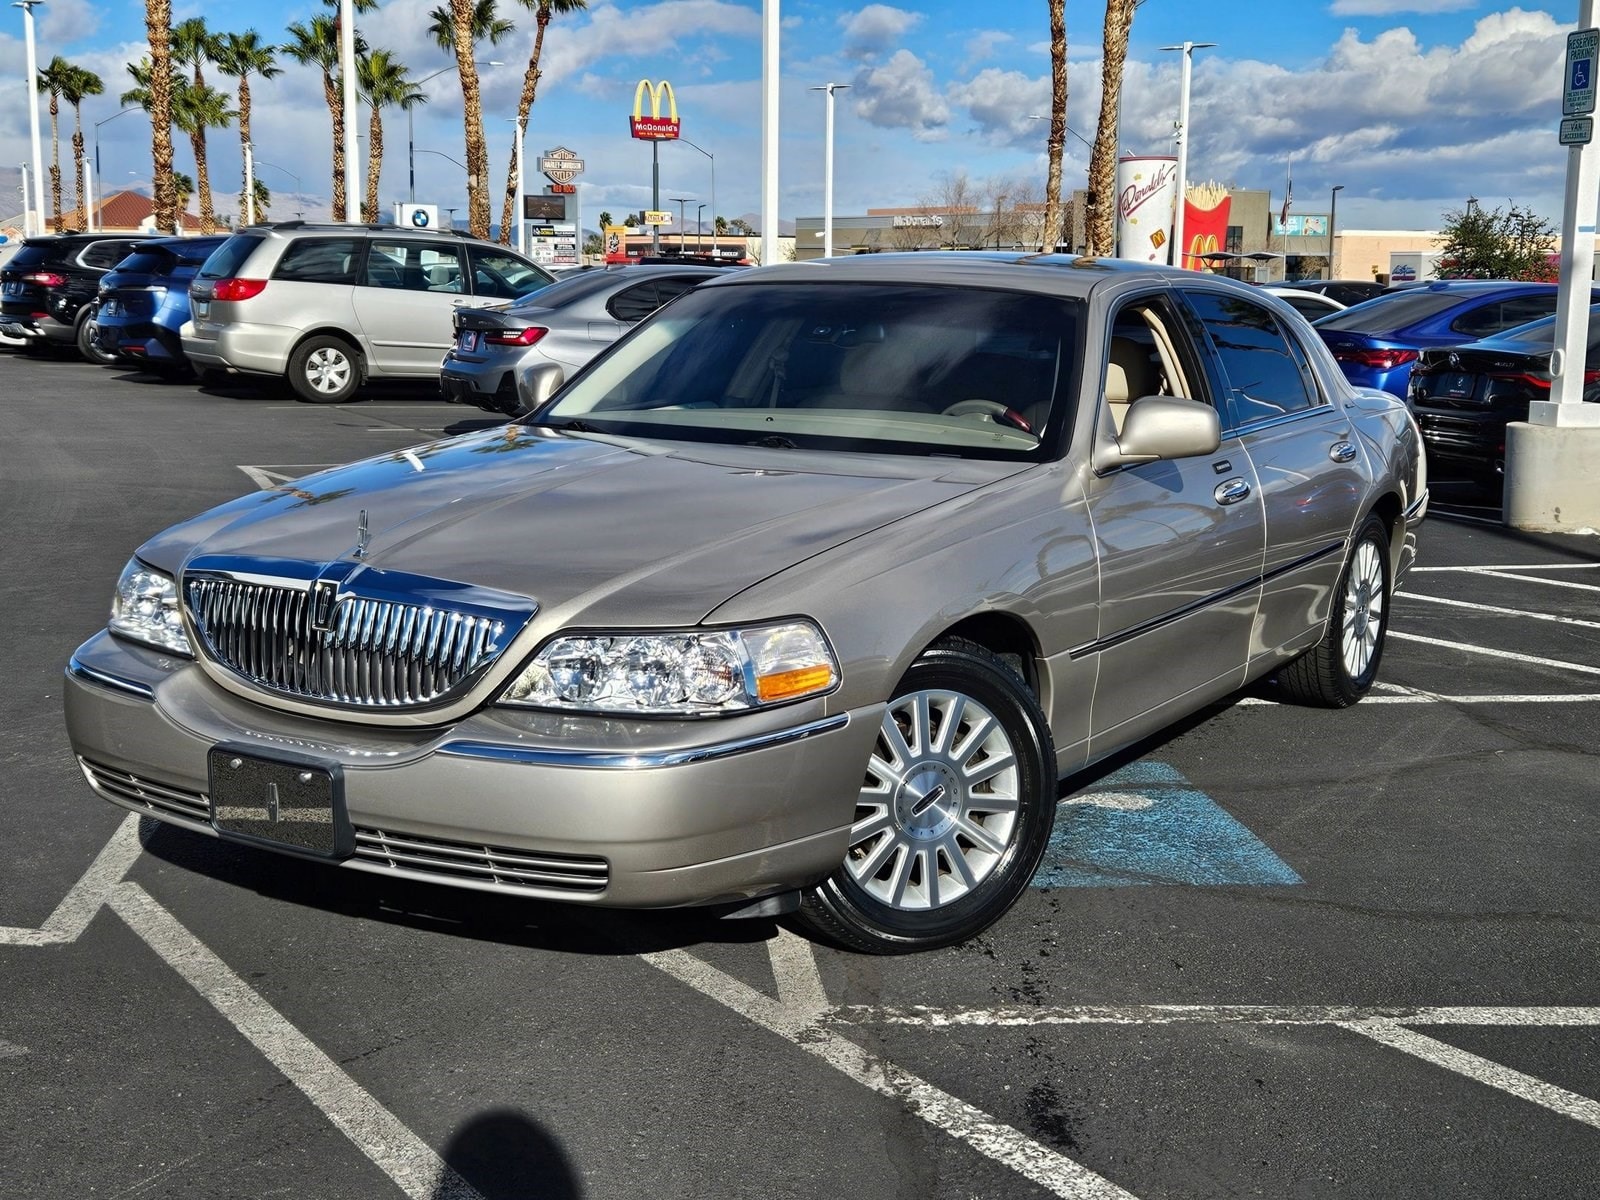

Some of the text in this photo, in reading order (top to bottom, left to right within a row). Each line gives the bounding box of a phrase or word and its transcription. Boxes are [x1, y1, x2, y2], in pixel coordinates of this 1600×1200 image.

[1569, 35, 1598, 50] RESERVED
[1570, 46, 1595, 60] PARKING
[635, 123, 678, 132] McDonald's
[1570, 122, 1583, 130] VAN
[893, 215, 943, 226] McDonald's
